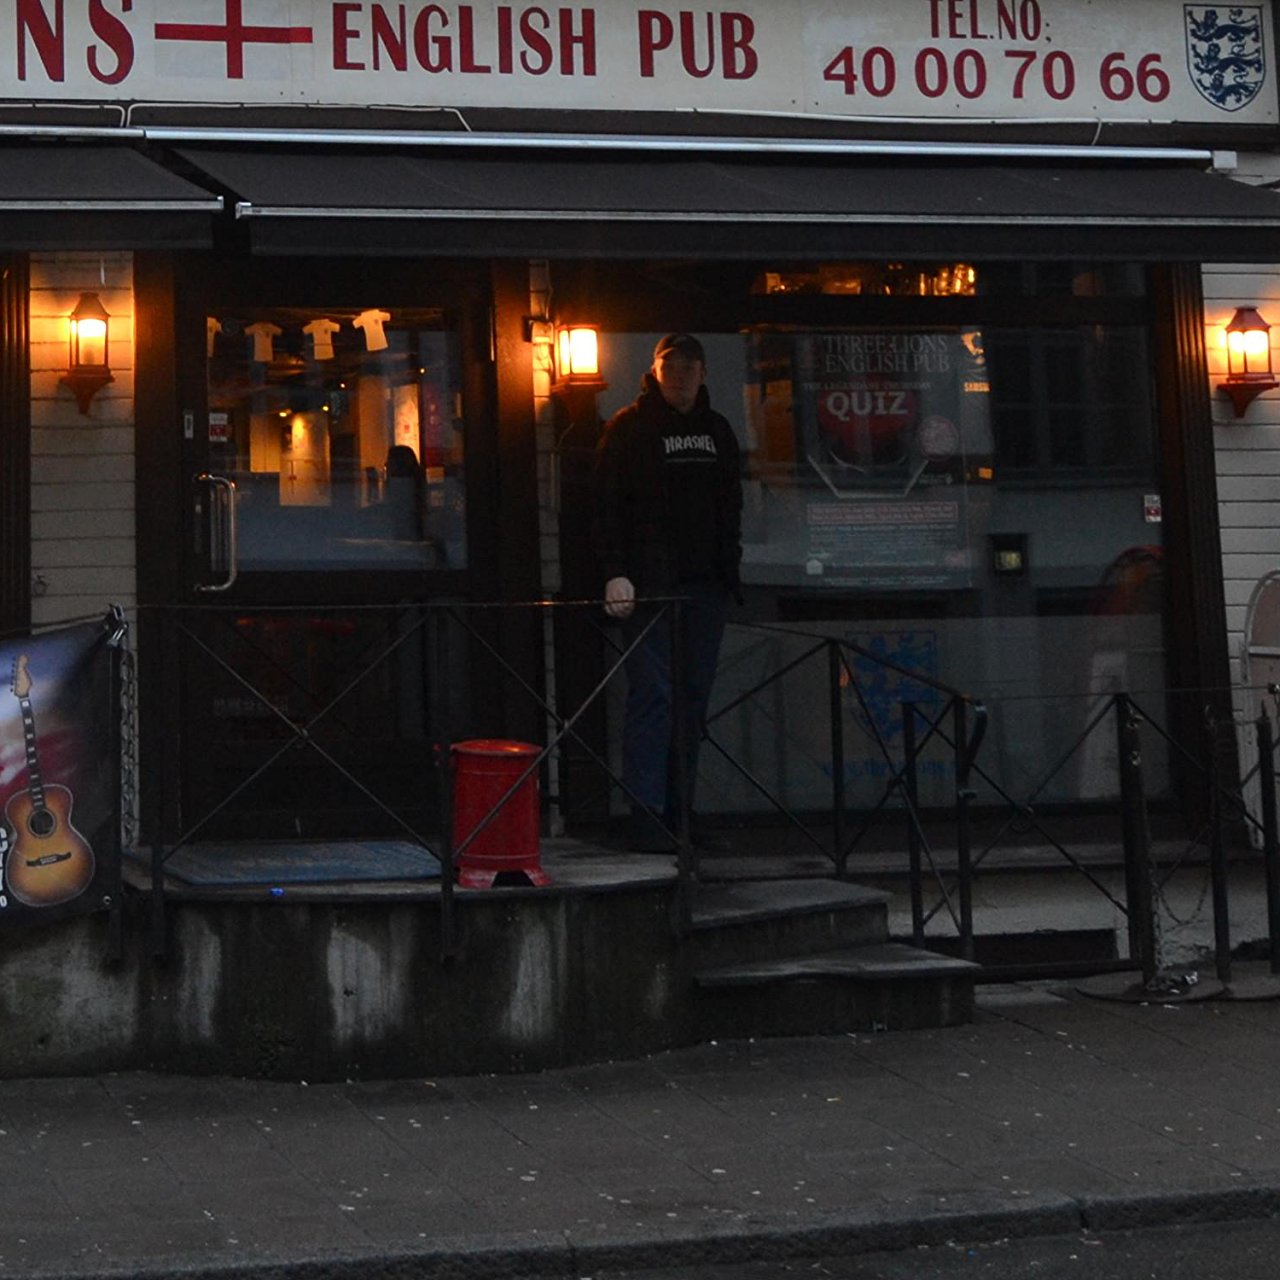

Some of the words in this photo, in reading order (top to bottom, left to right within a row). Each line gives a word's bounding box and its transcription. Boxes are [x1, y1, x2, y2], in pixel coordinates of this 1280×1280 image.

[332, 2, 596, 77] ENGLISH
[638, 9, 758, 80] PUB
[823, 46, 896, 97] 40
[915, 48, 987, 99] 00
[1004, 50, 1075, 100] 70
[1099, 52, 1170, 103] 66
[823, 335, 885, 353] THREE
[892, 335, 948, 353] LIONS
[825, 354, 907, 373] ENGLISH
[914, 354, 950, 373] PUB
[826, 391, 908, 420] QUIZ
